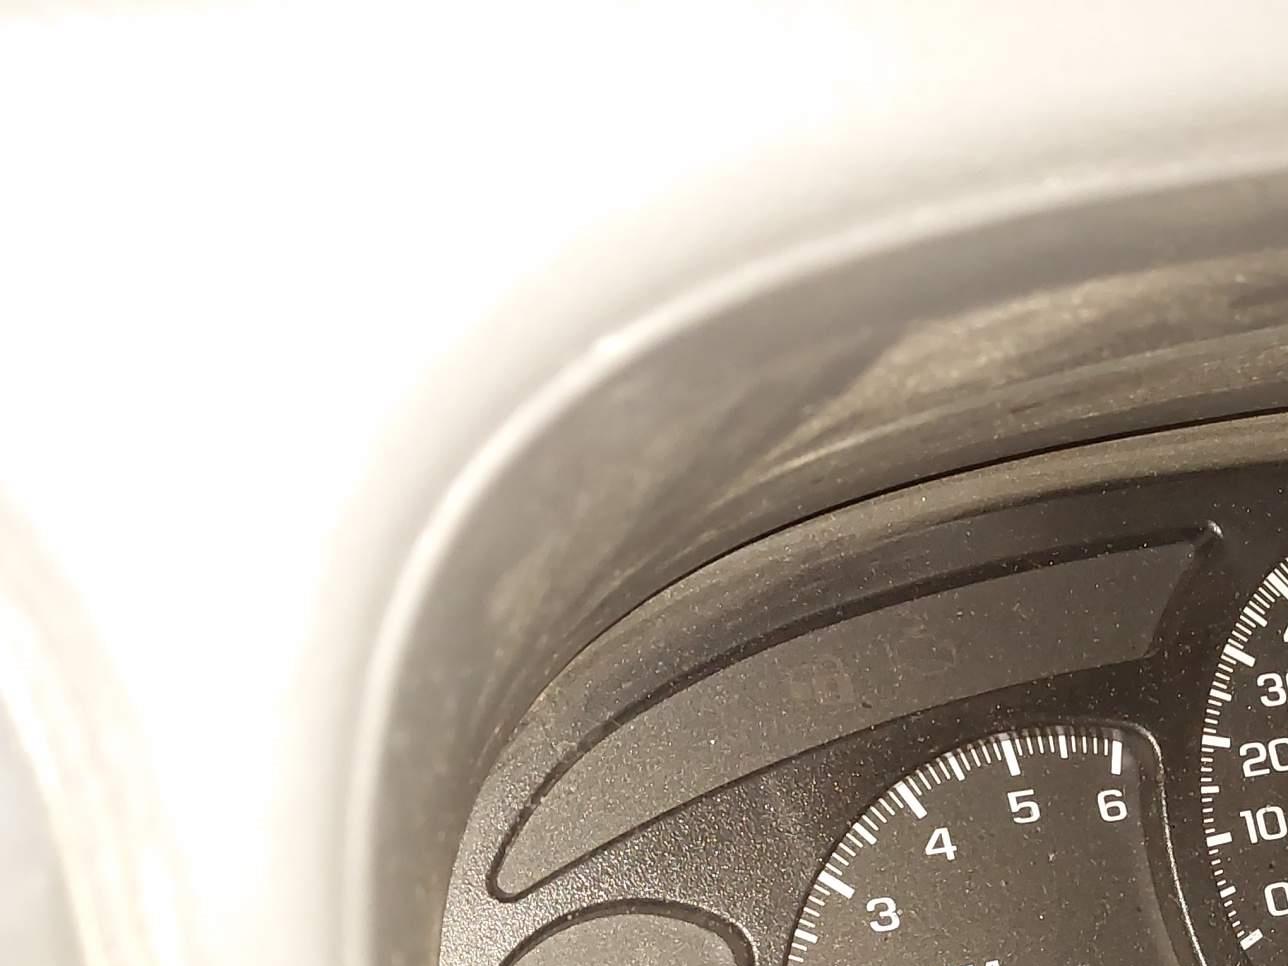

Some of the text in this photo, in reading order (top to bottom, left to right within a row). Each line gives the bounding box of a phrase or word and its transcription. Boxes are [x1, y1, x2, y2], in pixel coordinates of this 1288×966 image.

[1007, 789, 1041, 824] 5
[1097, 789, 1128, 822] 6
[1239, 805, 1288, 844] 10
[925, 827, 958, 861] 4
[866, 897, 900, 932] 3
